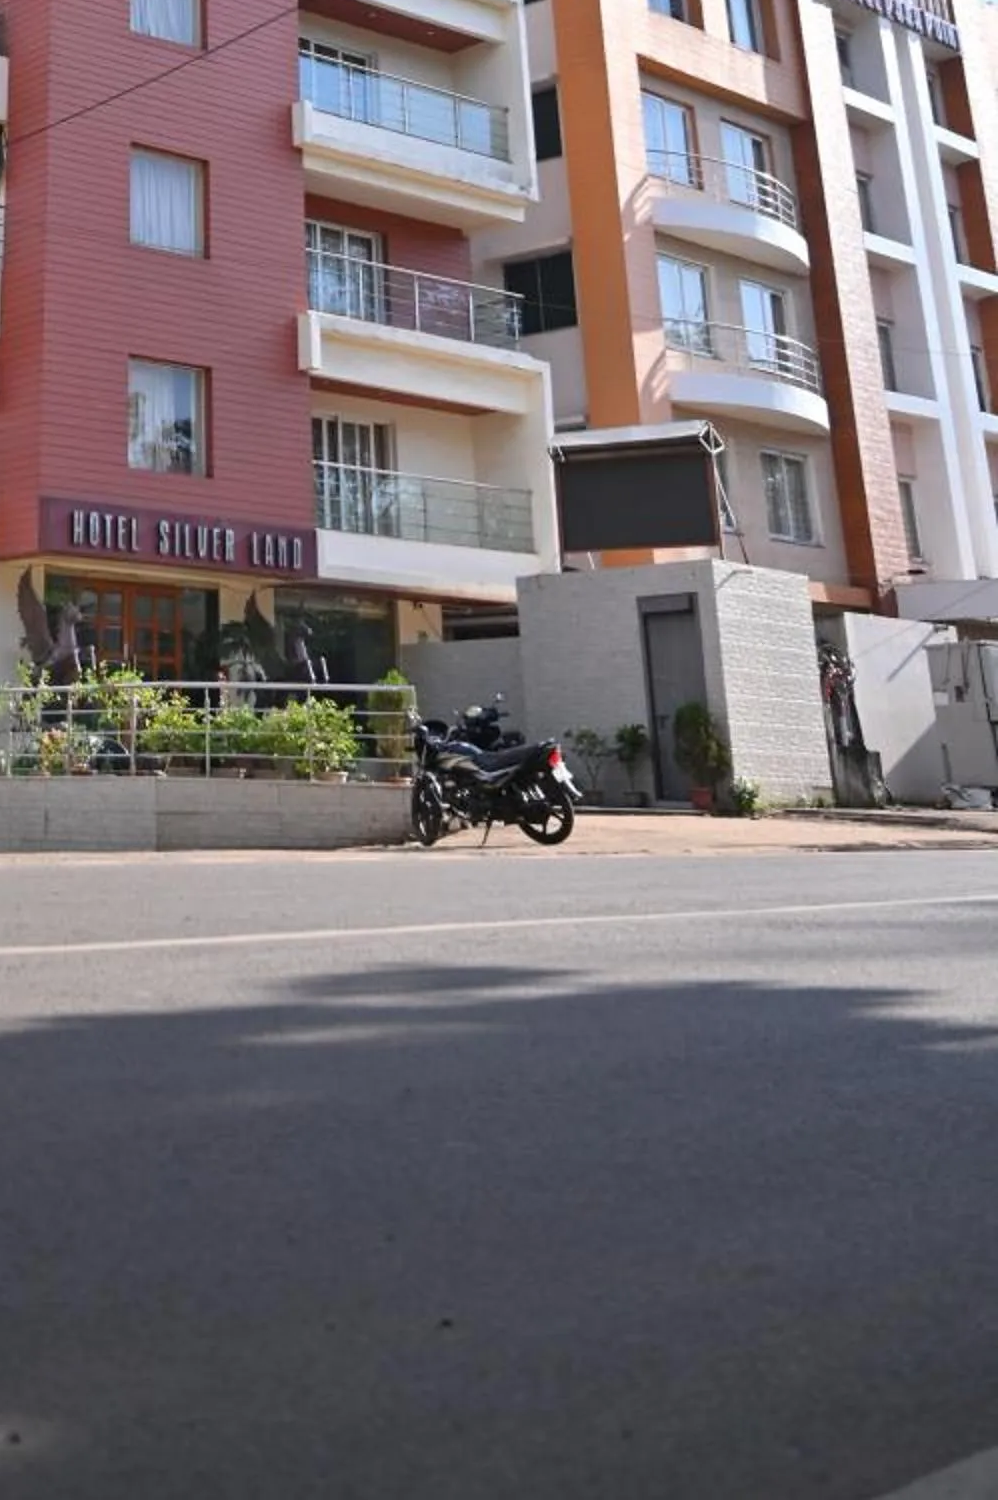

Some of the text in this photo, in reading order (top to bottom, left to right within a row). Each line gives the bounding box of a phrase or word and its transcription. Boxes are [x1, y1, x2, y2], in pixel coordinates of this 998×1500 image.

[72, 508, 303, 570] HOTEL SILVER LAND
